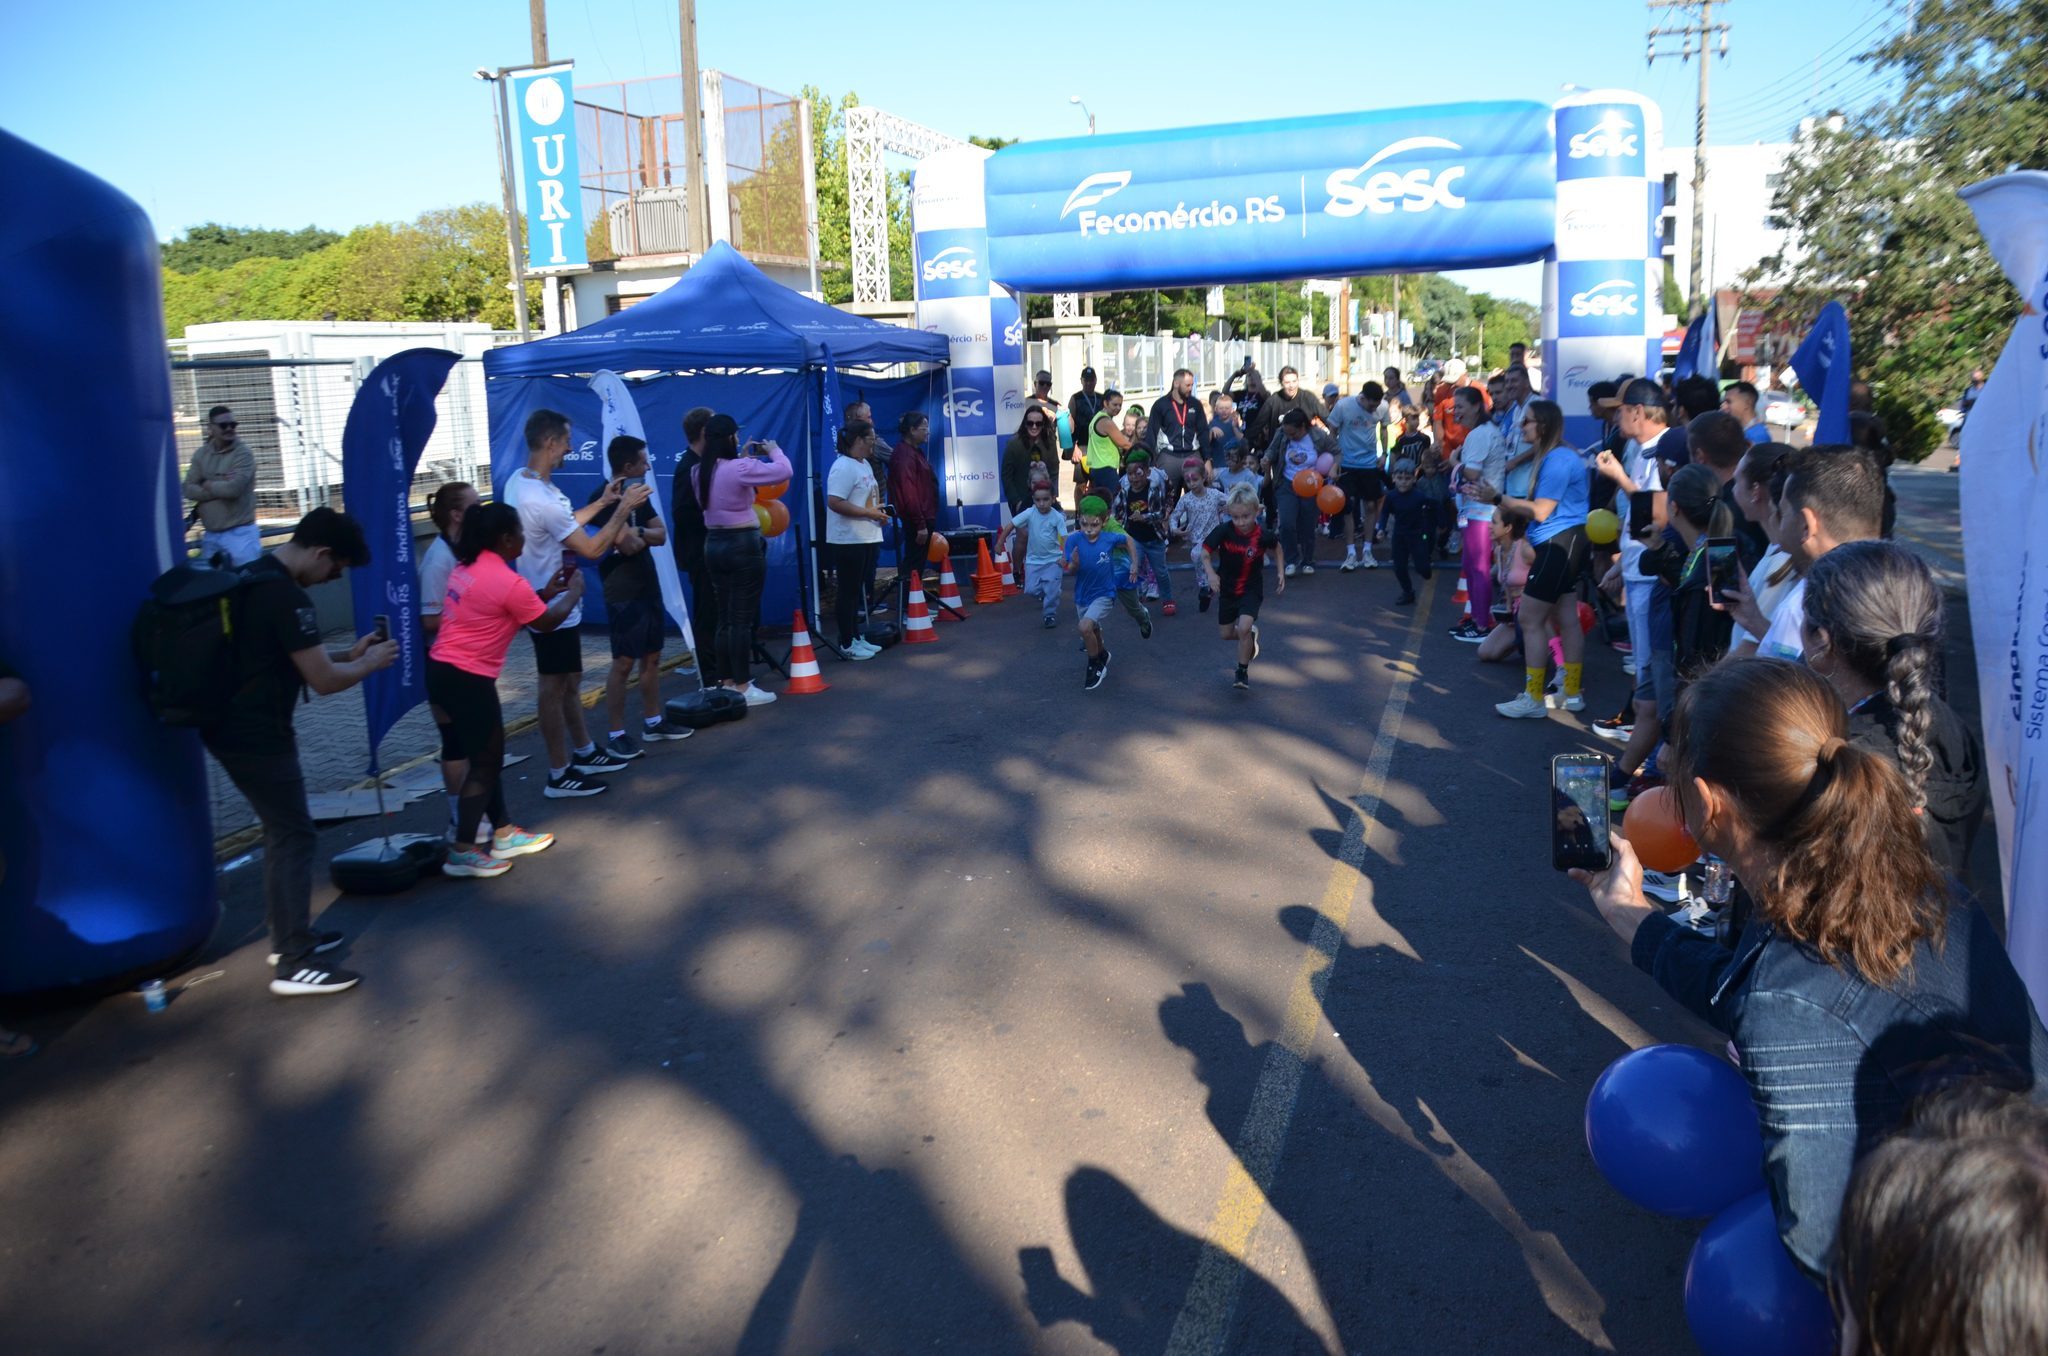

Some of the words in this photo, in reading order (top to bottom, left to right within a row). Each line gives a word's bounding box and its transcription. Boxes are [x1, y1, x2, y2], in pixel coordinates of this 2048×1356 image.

[532, 133, 571, 264] URI
[1078, 200, 1238, 238] Fecomércio
[1246, 195, 1286, 225] RS
[950, 334, 972, 343] ércio
[975, 333, 988, 342] RS
[943, 399, 984, 418] esc
[580, 450, 595, 461] RS
[982, 471, 996, 481] RS
[396, 492, 409, 563] Sindicatos
[398, 583, 410, 602] RS
